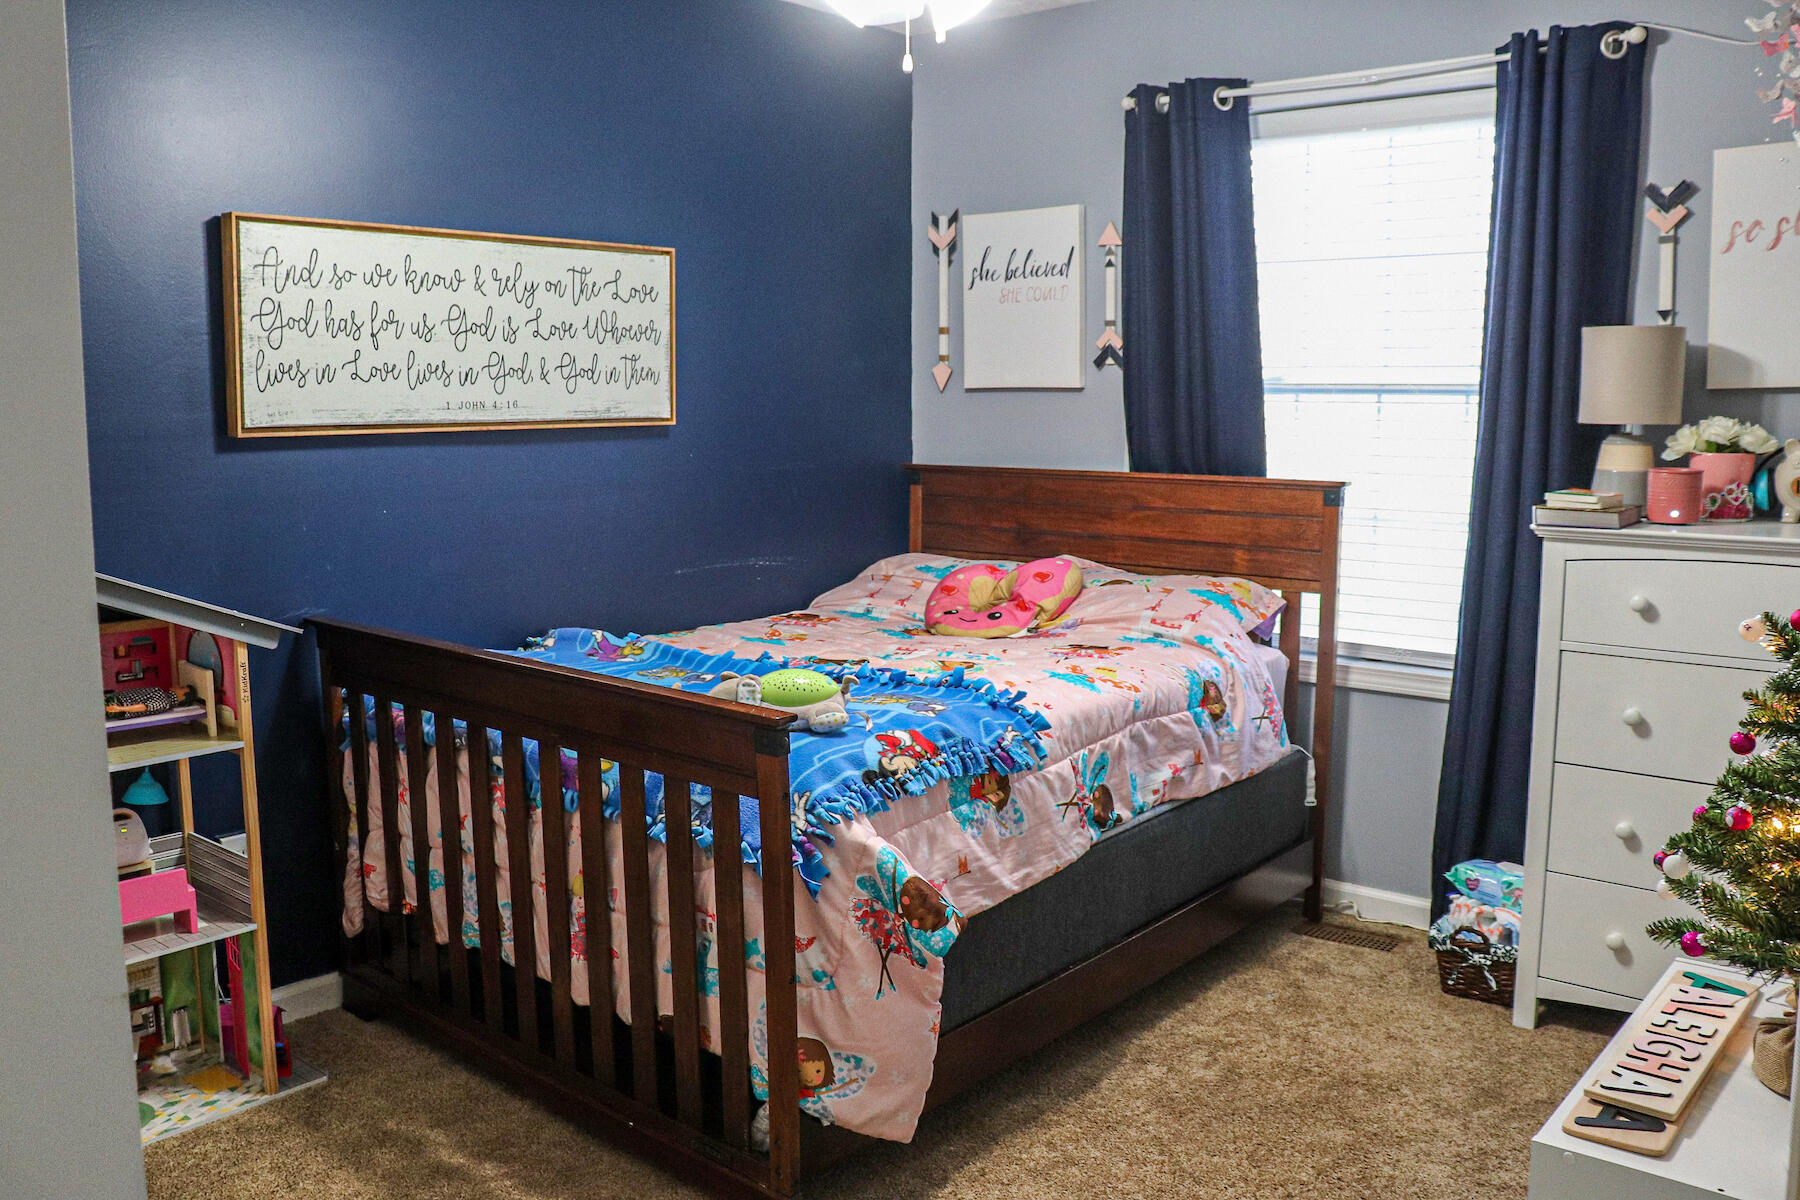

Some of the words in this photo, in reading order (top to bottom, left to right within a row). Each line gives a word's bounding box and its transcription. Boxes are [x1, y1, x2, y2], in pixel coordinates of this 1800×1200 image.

[1720, 219, 1765, 254] so
[253, 246, 323, 293] And
[329, 263, 357, 290] so
[363, 264, 397, 287] we
[404, 254, 466, 294] know
[474, 265, 487, 297] &
[492, 262, 539, 309] rely
[545, 279, 567, 298] on
[603, 269, 658, 303] Love
[968, 245, 1000, 290] she
[1004, 245, 1074, 283] believed
[1000, 286, 1021, 304] SHE
[1026, 284, 1069, 302] COULD
[251, 297, 318, 350] God
[325, 299, 364, 340] has
[371, 301, 404, 350] for
[441, 304, 496, 352] God
[502, 316, 519, 344] is
[583, 310, 661, 345] Whoever
[256, 349, 309, 392] lives
[315, 362, 336, 385] in
[342, 349, 401, 383] Love
[407, 350, 453, 390] lives
[458, 365, 479, 386] in
[539, 357, 550, 385] &
[554, 352, 602, 394] God
[605, 366, 620, 386] in
[446, 401, 450, 410] 1
[458, 400, 486, 410] JOHN
[493, 399, 518, 409] 4:16
[1600, 986, 1735, 1098] ALEIGHA
